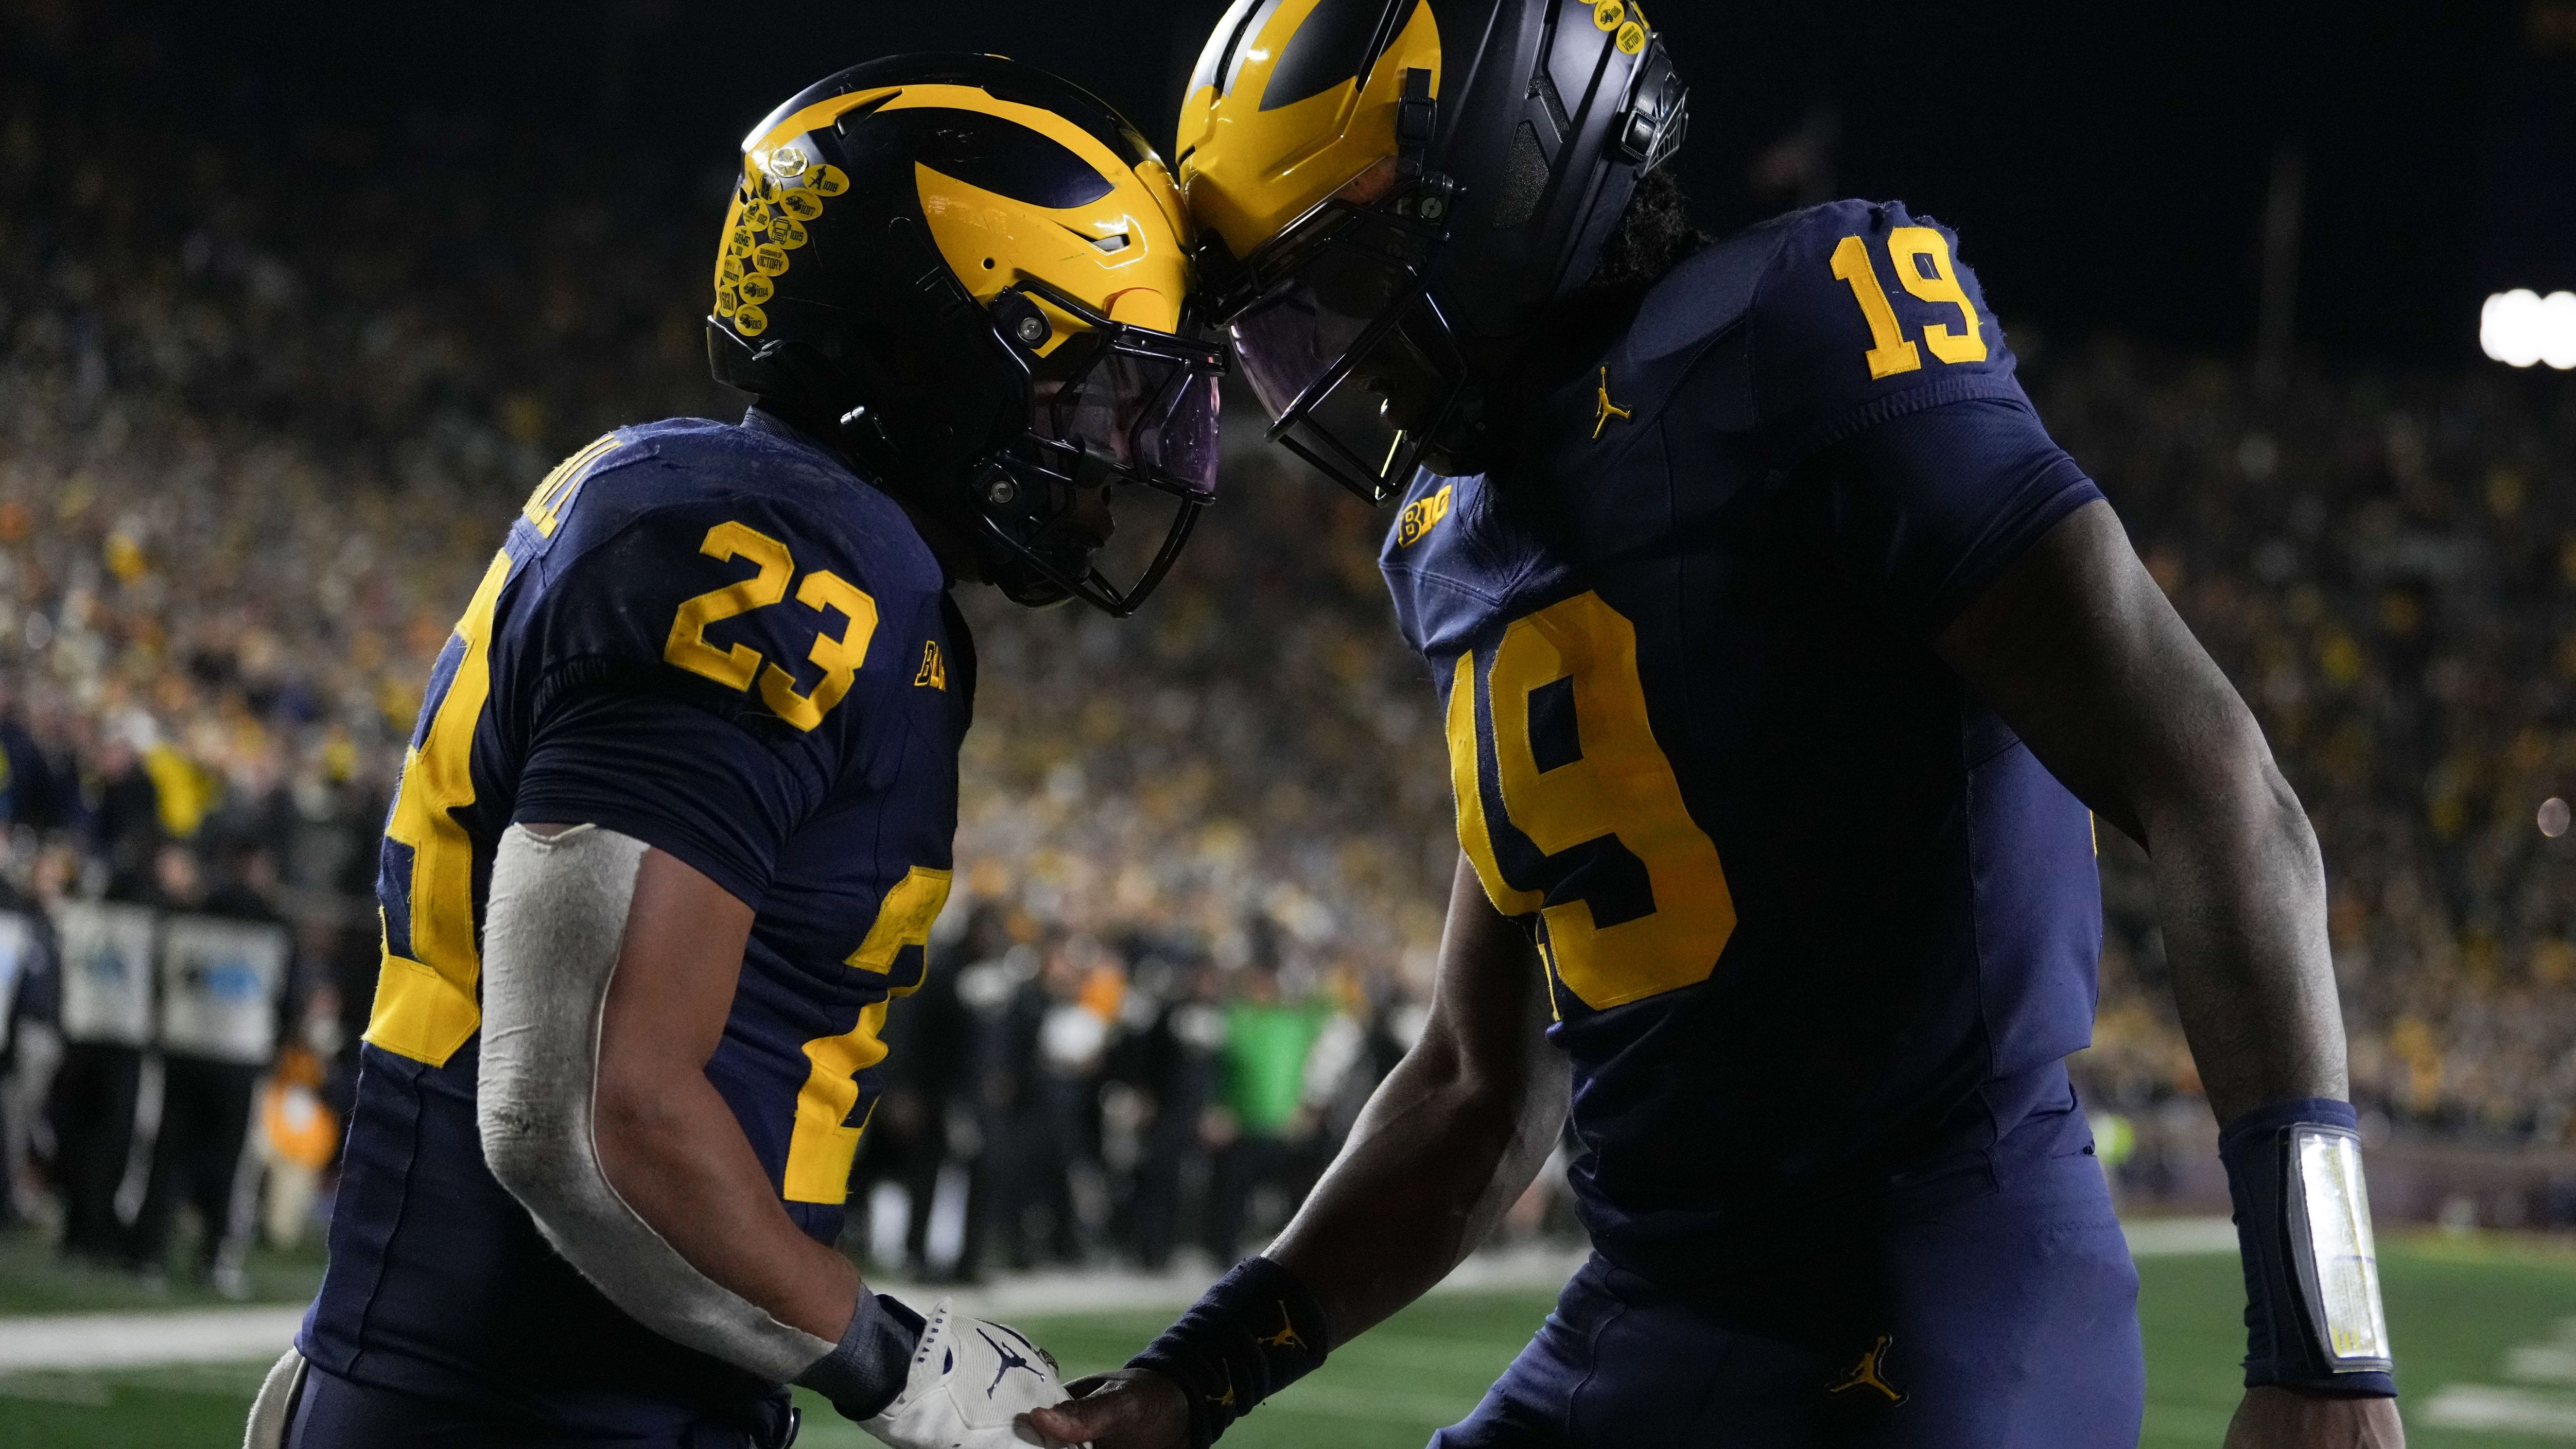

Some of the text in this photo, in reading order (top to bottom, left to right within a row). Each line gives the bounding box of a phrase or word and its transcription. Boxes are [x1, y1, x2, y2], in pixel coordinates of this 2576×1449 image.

[1623, 31, 1642, 51] VICTORY
[824, 181, 839, 193] 1018
[800, 206, 816, 216] 1017
[757, 213, 768, 225] 1012
[734, 233, 750, 247] GAME
[790, 230, 804, 241] 1015
[757, 255, 783, 271] VICTORY
[757, 288, 768, 297] 1014
[1829, 226, 1987, 381] 19
[751, 320, 761, 329] 1013
[664, 520, 879, 732] 23
[1446, 590, 1738, 1021] 19
